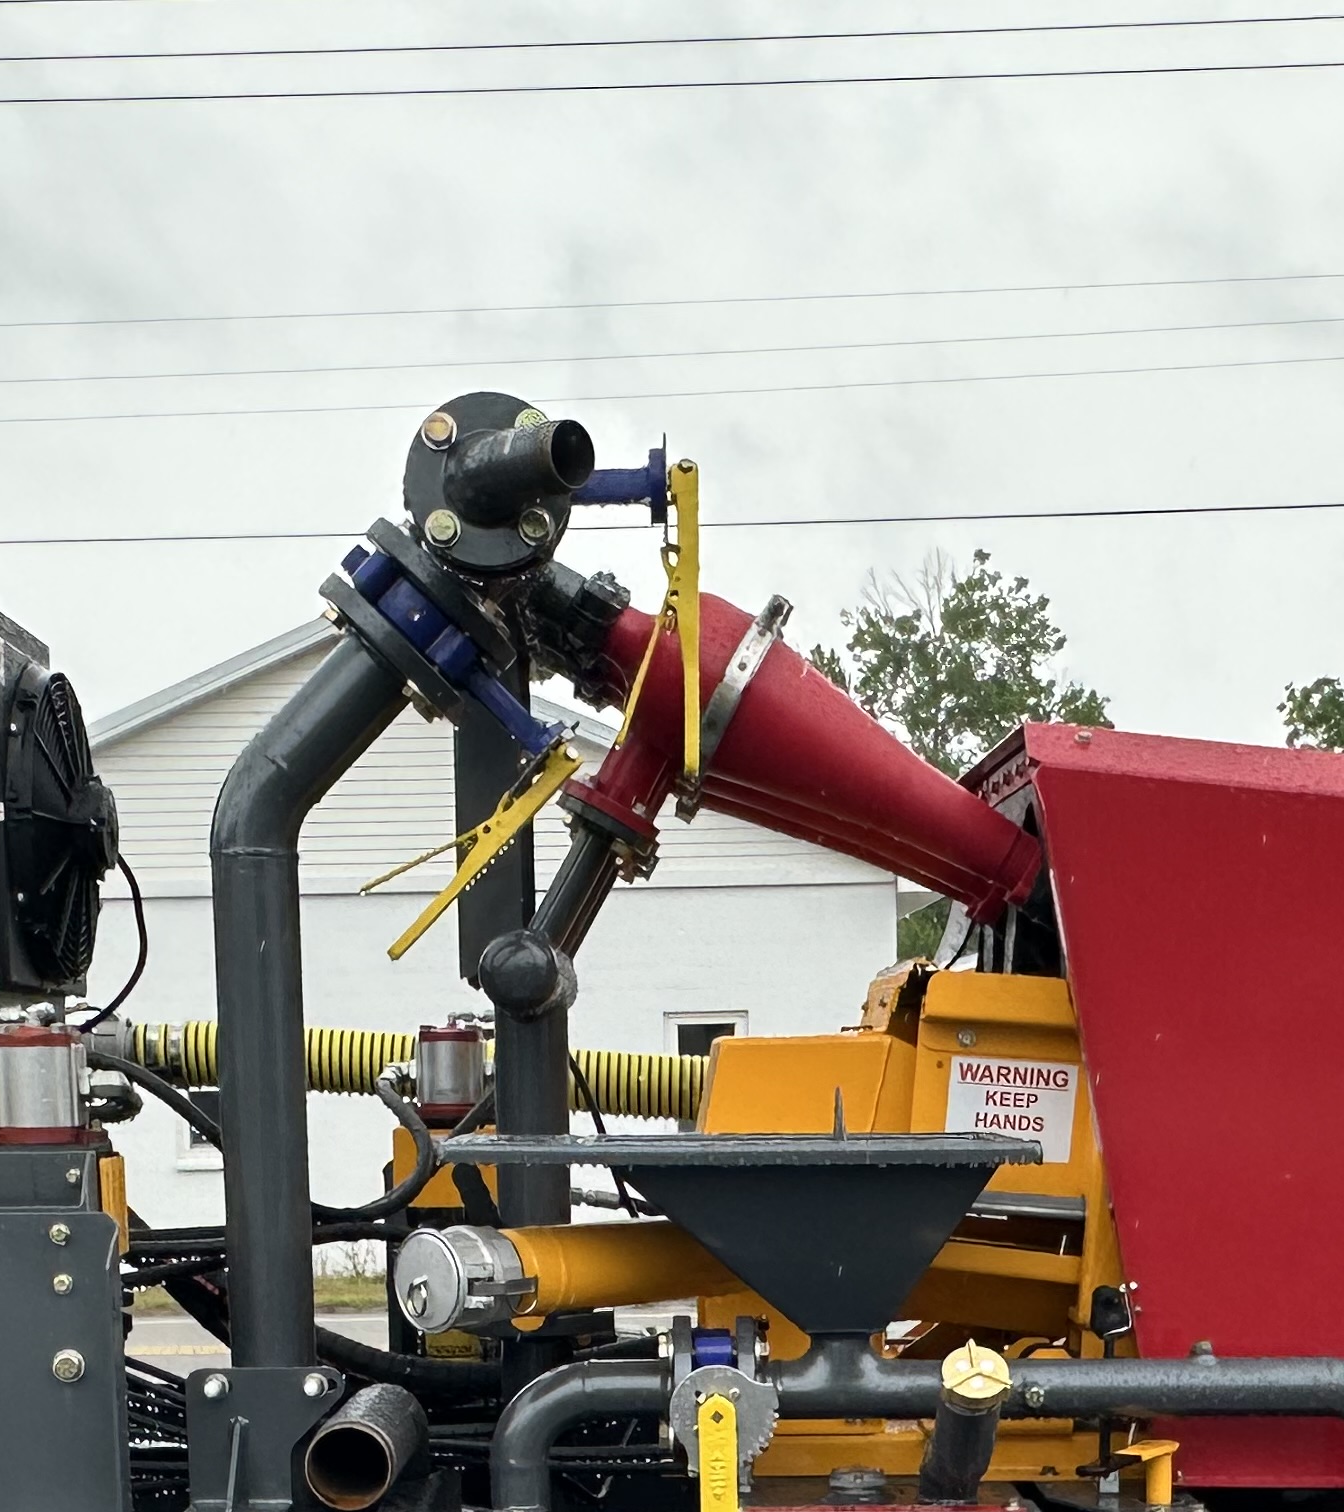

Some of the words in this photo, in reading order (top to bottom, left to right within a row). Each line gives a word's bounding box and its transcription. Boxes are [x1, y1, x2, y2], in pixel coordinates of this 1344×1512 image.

[959, 1062, 1069, 1087] WARNING
[985, 1090, 1038, 1108] KEEP
[975, 1112, 1044, 1132] HANDS
